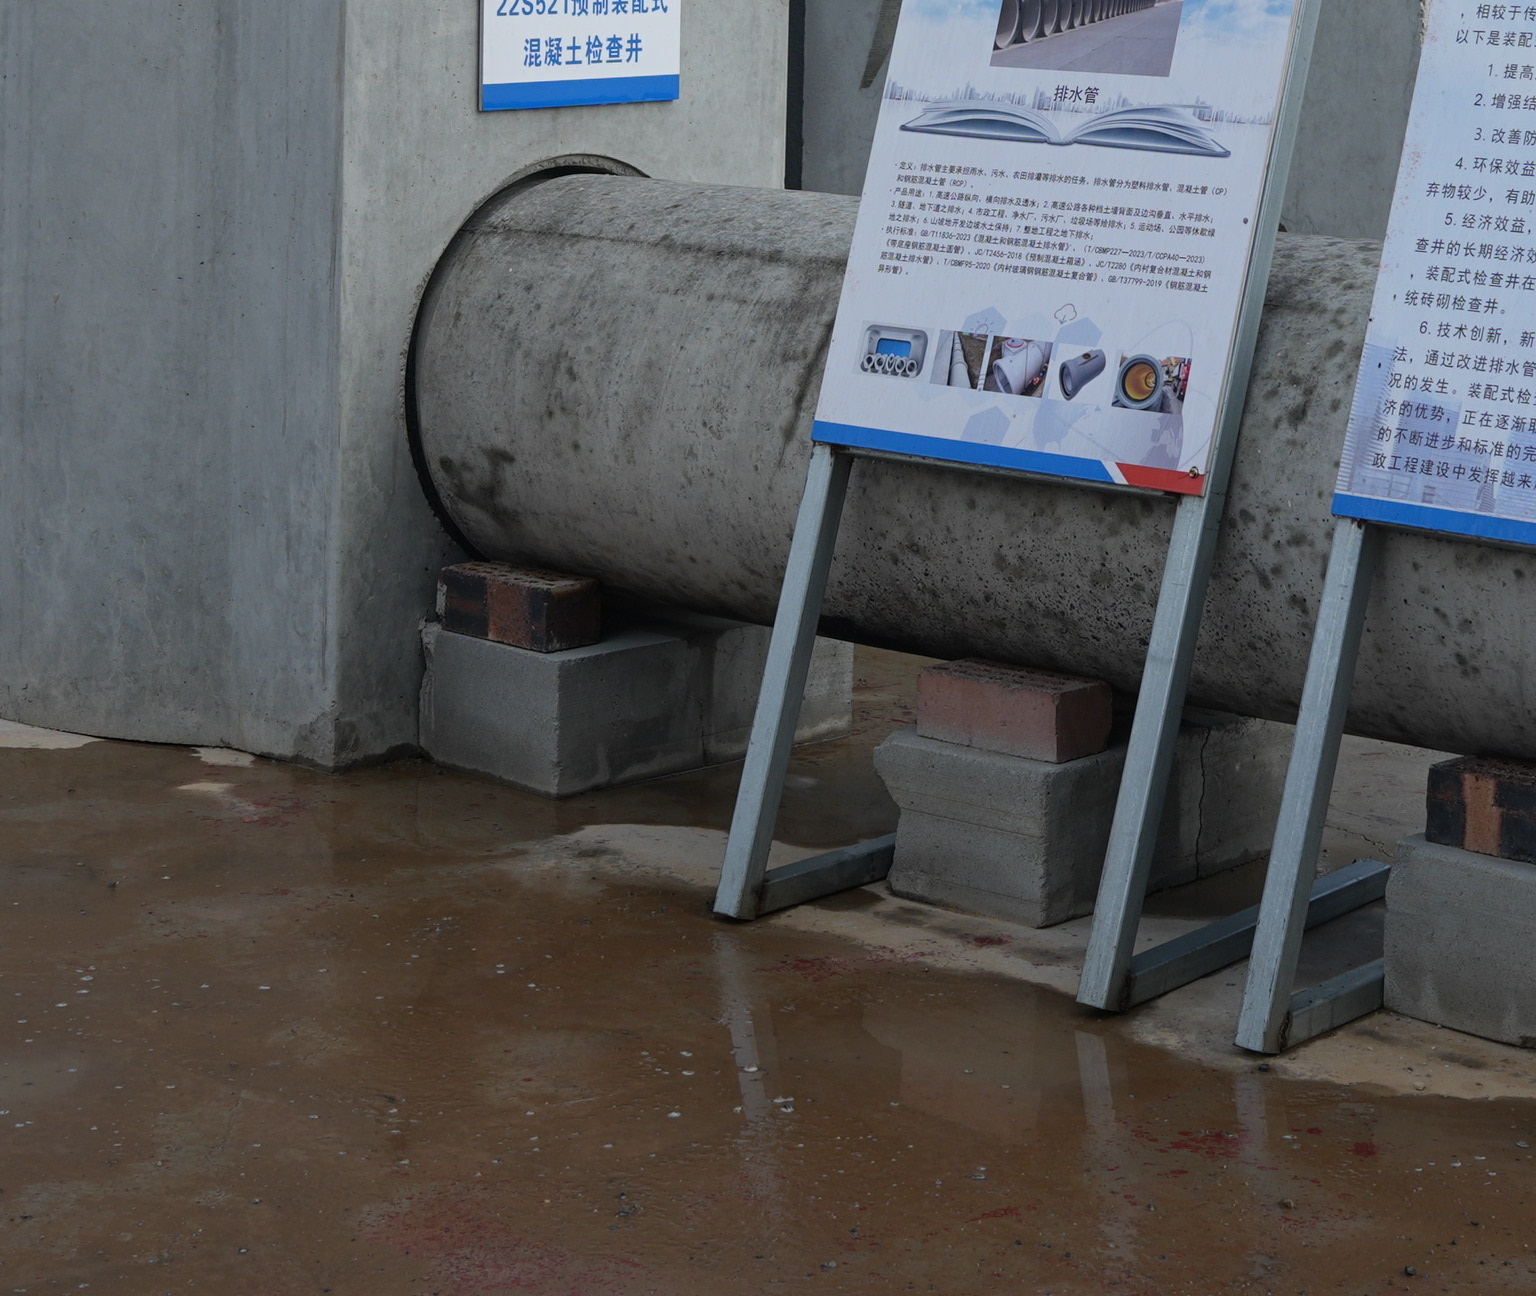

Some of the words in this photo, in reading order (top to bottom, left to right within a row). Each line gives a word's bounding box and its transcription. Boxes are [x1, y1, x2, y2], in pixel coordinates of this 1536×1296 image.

[524, 33, 642, 67] 混凝土检查井
[1054, 85, 1099, 106] 排水管
